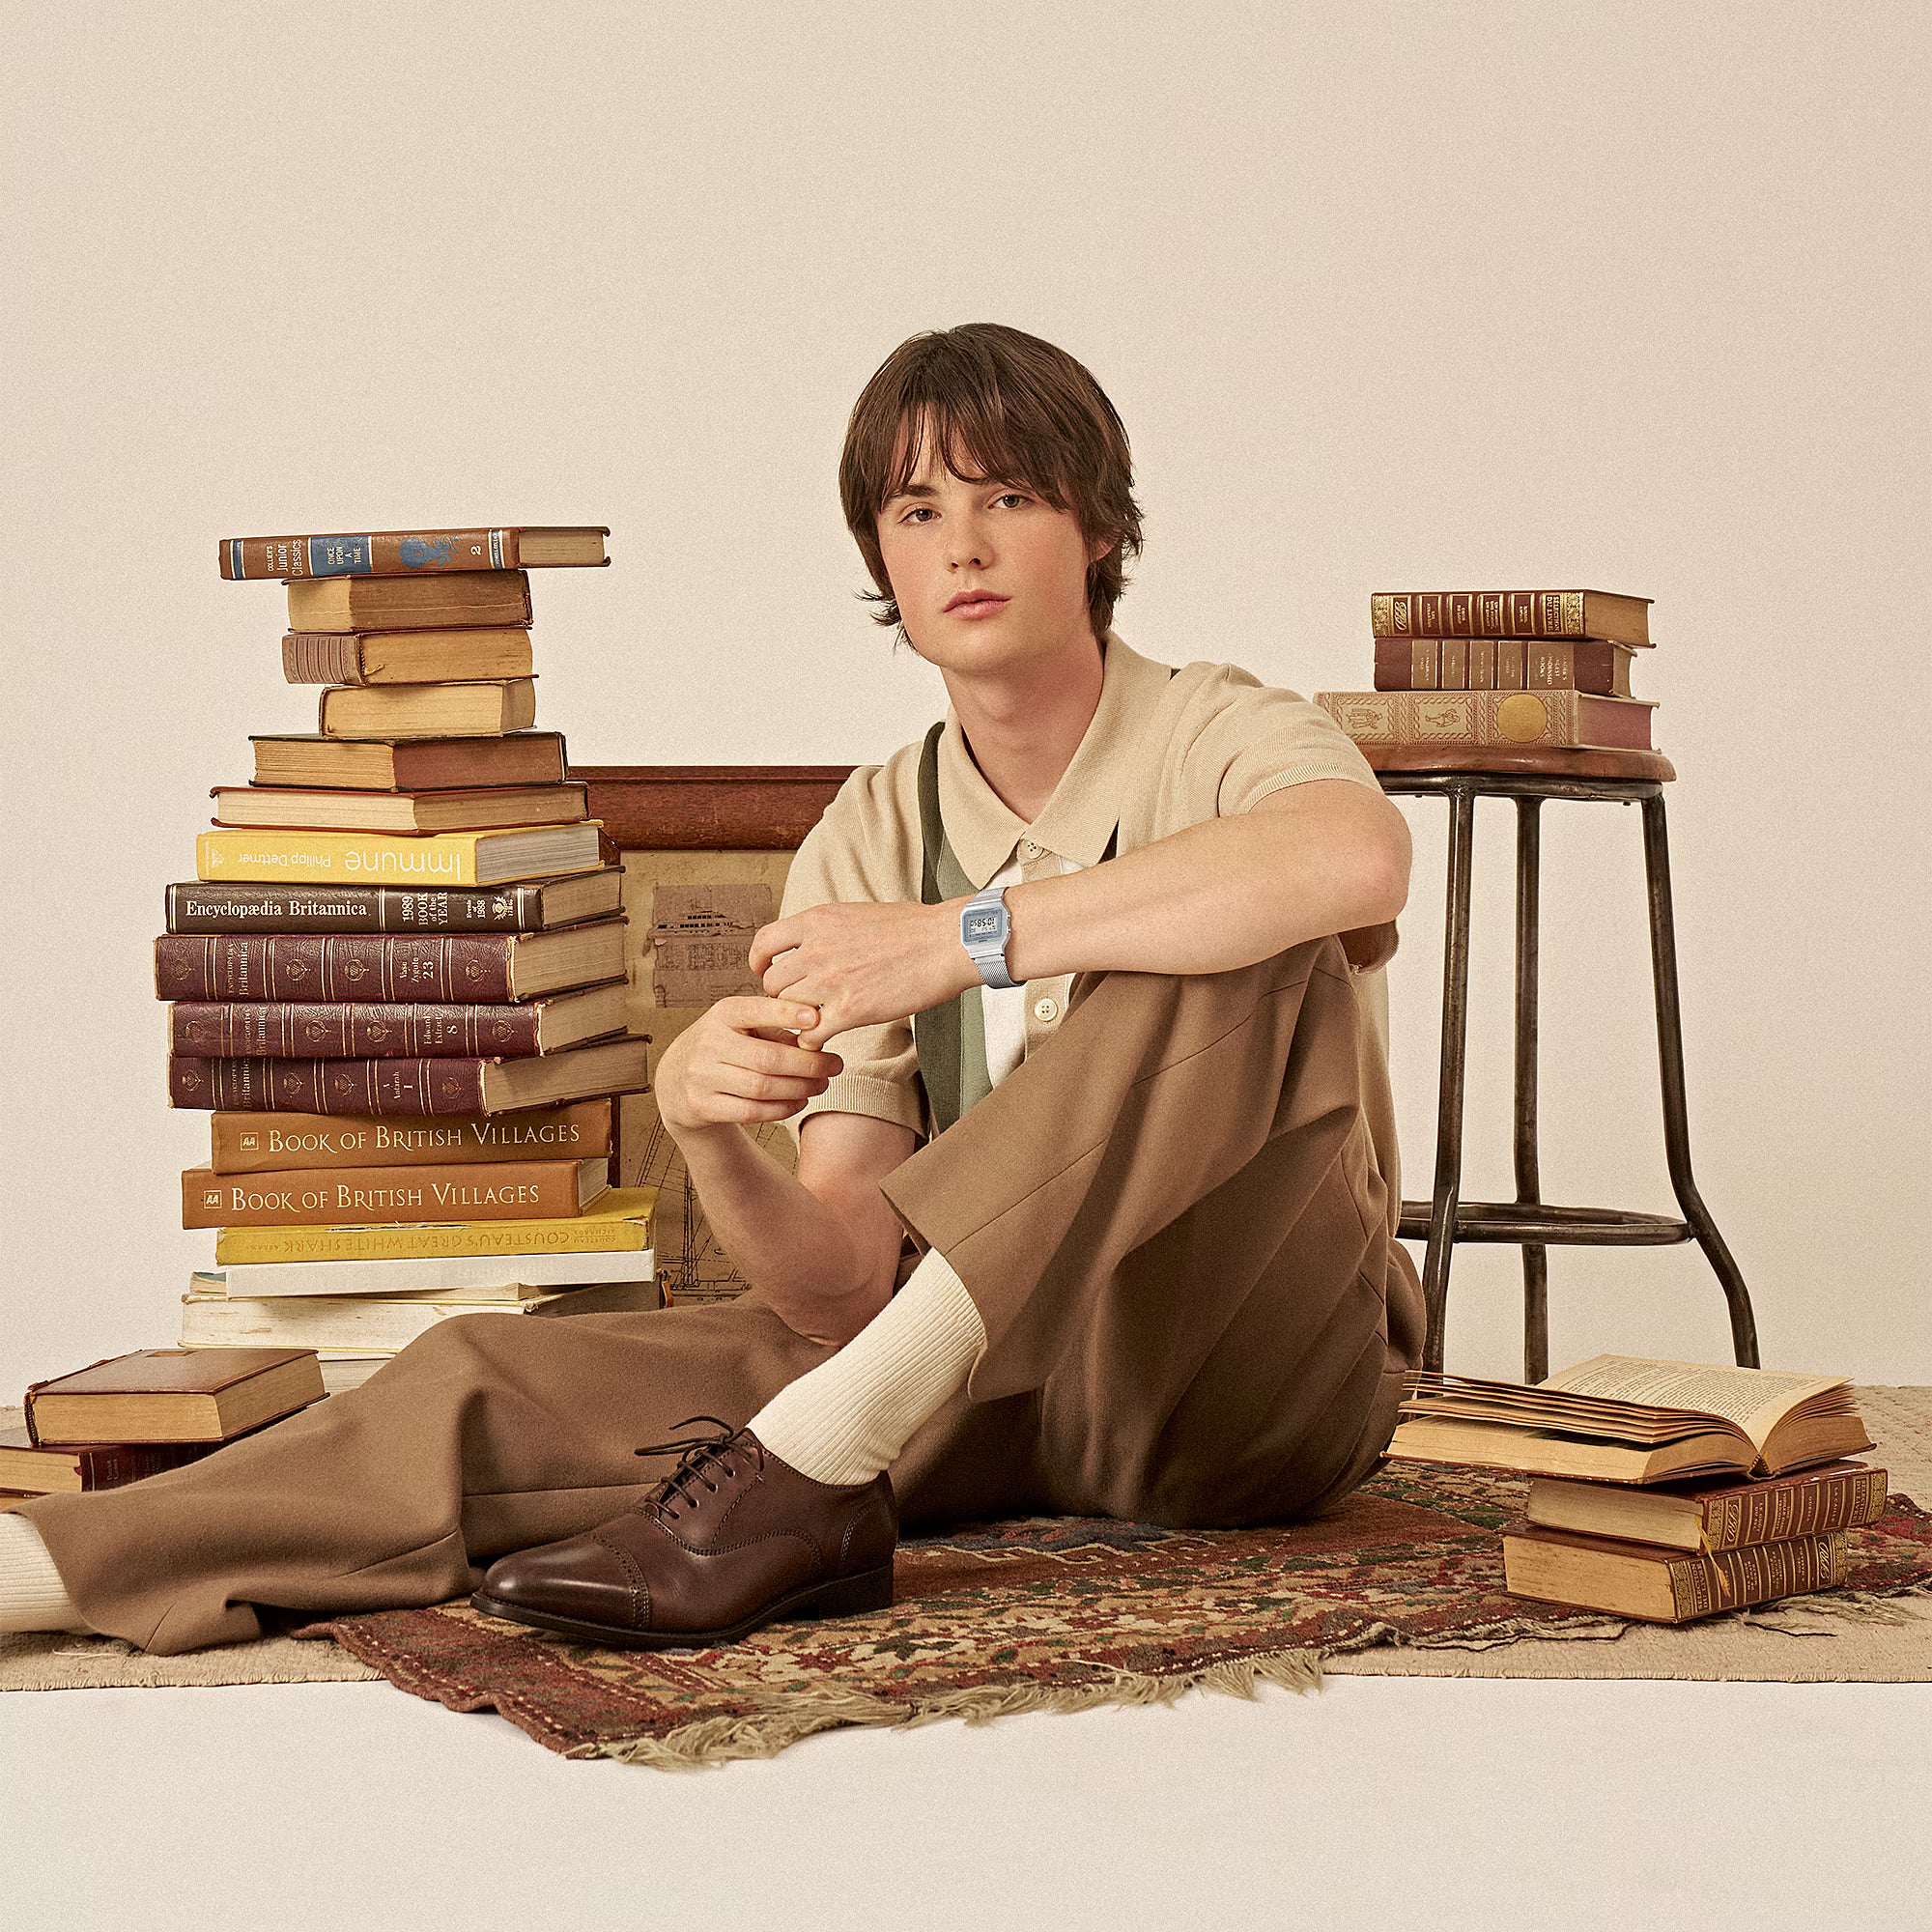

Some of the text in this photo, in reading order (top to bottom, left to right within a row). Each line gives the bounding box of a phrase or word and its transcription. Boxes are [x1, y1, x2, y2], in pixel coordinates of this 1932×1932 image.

[275, 544, 288, 571] Junior
[291, 539, 303, 576] Classics
[327, 548, 335, 564] ONCE
[470, 546, 481, 554] 2
[1548, 597, 1552, 607] DU
[237, 852, 331, 867] Philipp Dettmer
[345, 851, 461, 880] Immune
[186, 900, 367, 918] Encyclopædia Britannica
[402, 896, 413, 922] 1989
[418, 893, 428, 925] BOOK
[430, 913, 437, 922] of
[438, 893, 448, 925] YEAR
[239, 942, 249, 995] Britannica
[422, 961, 434, 980] 23
[446, 1025, 458, 1035] 8
[269, 1130, 337, 1154] BOOK
[340, 1131, 366, 1150] OF
[375, 1125, 462, 1151] BRITISH
[471, 1122, 580, 1146] VILLAGES
[231, 1188, 299, 1212] BOOK
[302, 1191, 328, 1208] OF
[336, 1185, 422, 1211] BRITISH
[432, 1183, 540, 1206] VILLAGES
[284, 1232, 569, 1253] COUSTEAU'S GREAT WHITE SHARK
